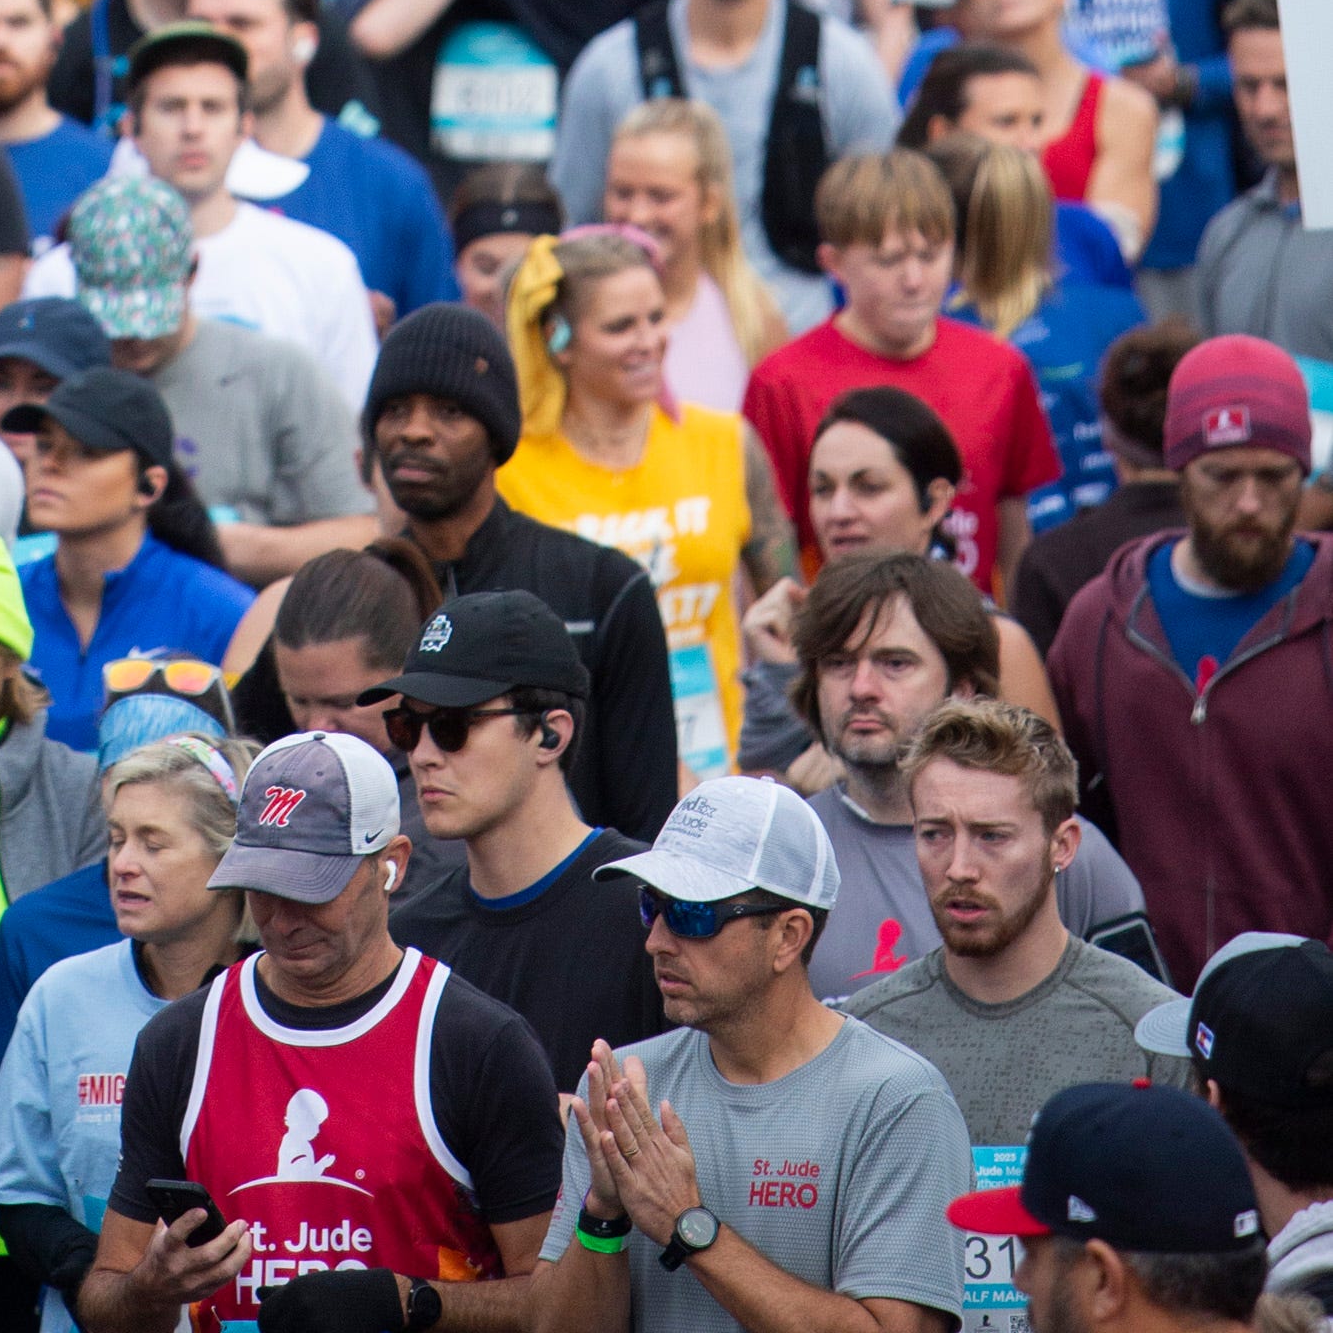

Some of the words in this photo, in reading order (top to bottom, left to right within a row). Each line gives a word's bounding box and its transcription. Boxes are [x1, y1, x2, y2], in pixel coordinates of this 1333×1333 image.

[752, 1159, 773, 1176] St.
[777, 1159, 820, 1178] Jude
[748, 1180, 819, 1210] HERO
[284, 1219, 373, 1252] Jude
